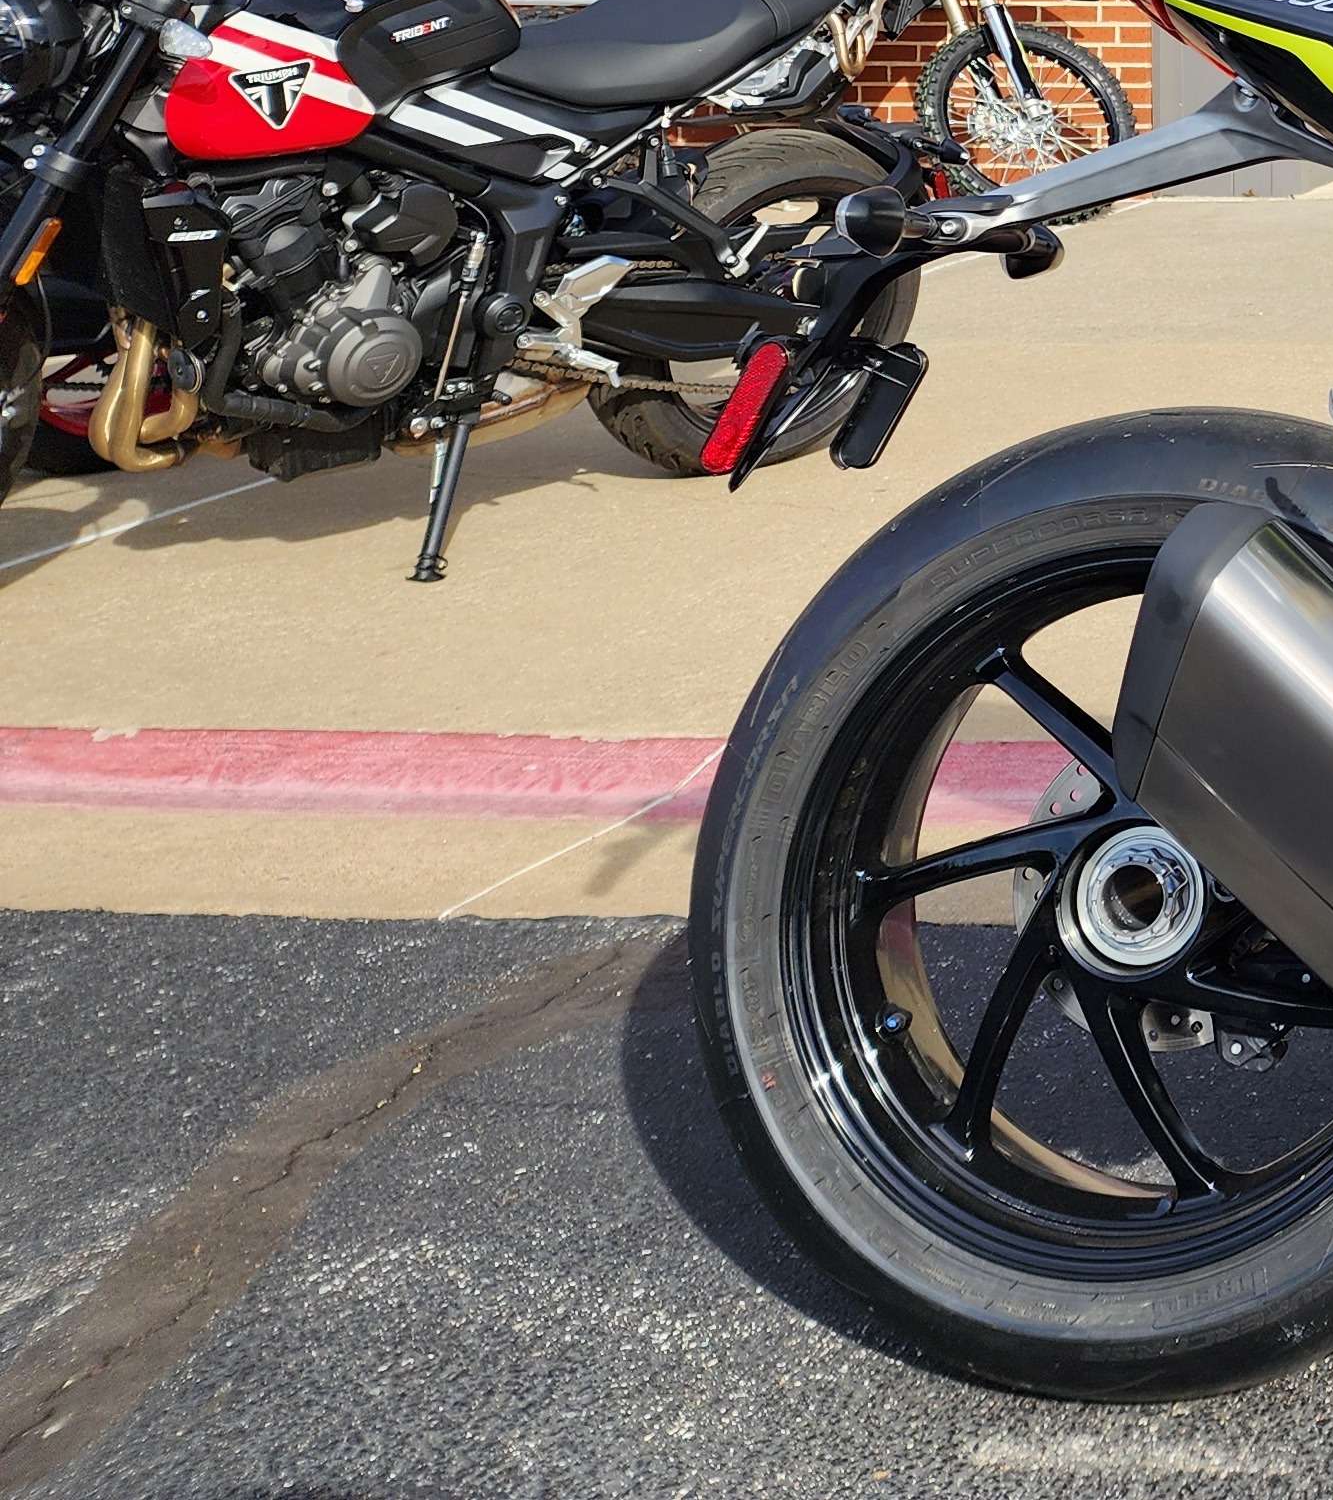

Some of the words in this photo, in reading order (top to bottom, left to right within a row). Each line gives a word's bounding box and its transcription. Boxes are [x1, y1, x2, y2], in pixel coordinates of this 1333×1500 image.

[391, 16, 450, 44] TRIDENT
[245, 66, 299, 85] TRIUMPH
[926, 506, 1150, 592] SUPERCORSA
[711, 673, 803, 935] SUPERCORSA
